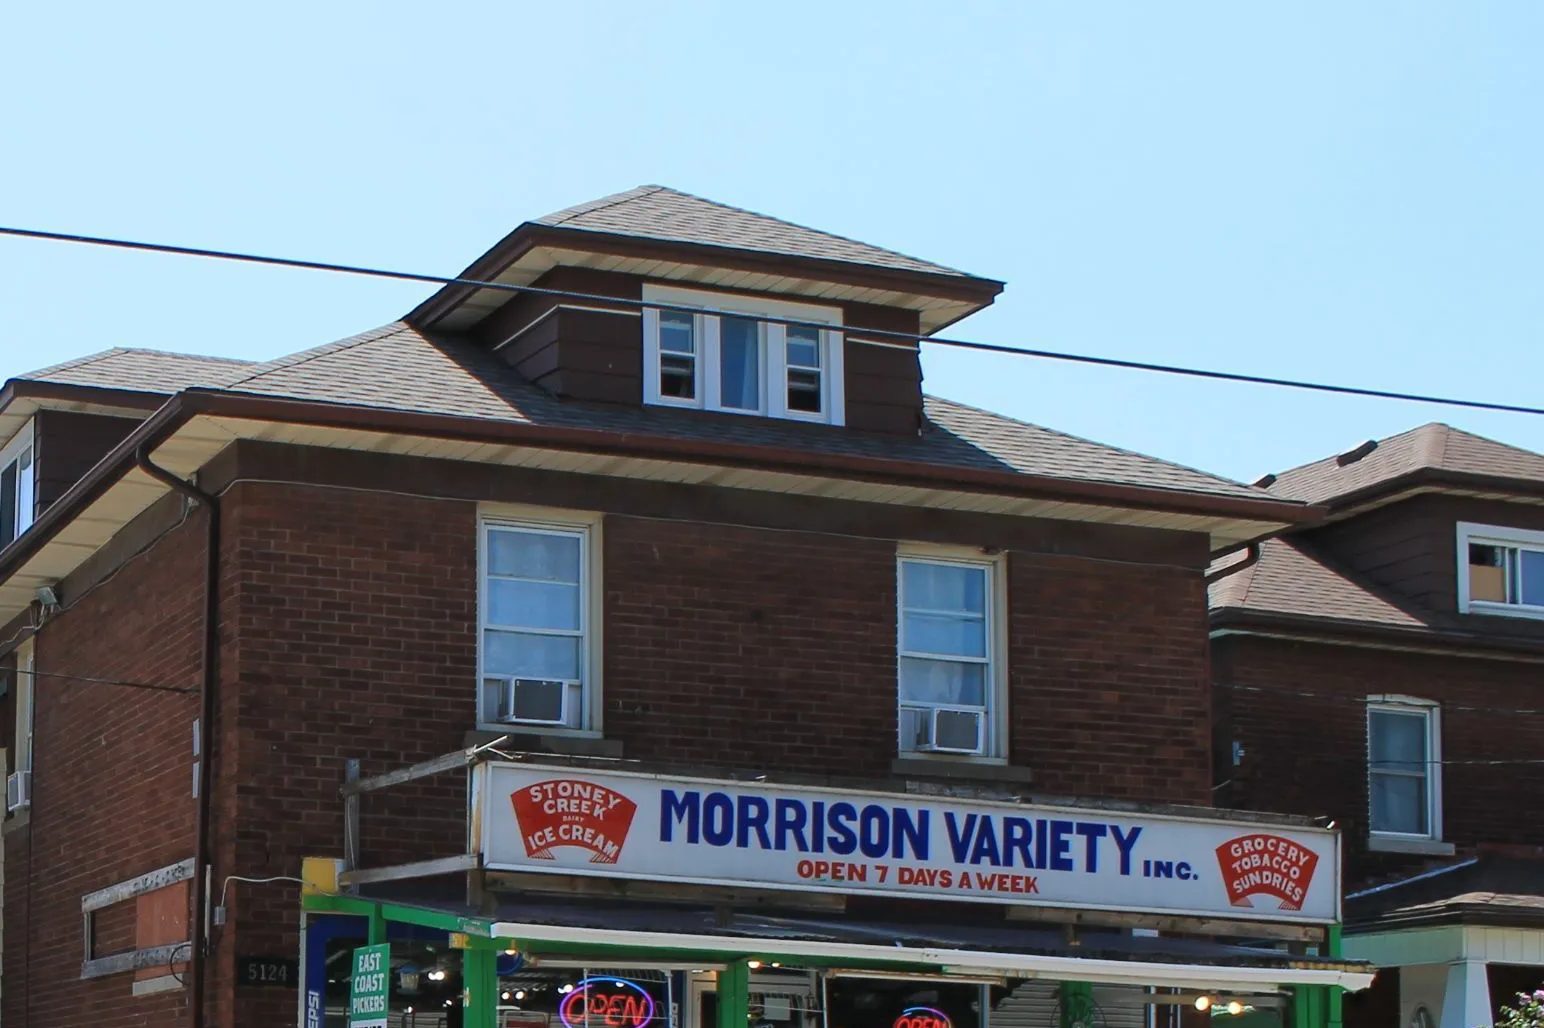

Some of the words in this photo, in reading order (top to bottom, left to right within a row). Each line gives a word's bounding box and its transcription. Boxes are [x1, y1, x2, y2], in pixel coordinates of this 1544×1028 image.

[529, 781, 621, 809] STONEY
[543, 798, 607, 820] CREEK
[528, 826, 556, 850] ICE
[558, 824, 619, 858] CREAM
[659, 788, 929, 861] MORRISON
[944, 811, 1143, 876] VARIETY
[1143, 859, 1199, 881] INC.
[1230, 838, 1310, 867] GROCERY
[1231, 853, 1301, 879] TOBACCO
[796, 859, 867, 882] OPEN
[874, 865, 889, 883] 7
[898, 867, 953, 889] DAYS
[958, 871, 973, 889] A
[975, 872, 1040, 894] WEEK
[1232, 870, 1303, 902] SUNDRIES
[247, 963, 289, 982] 5124
[358, 952, 382, 973] EAST
[354, 973, 385, 994] COAST
[352, 995, 385, 1014] PICKERS
[565, 993, 648, 1027] OPEN
